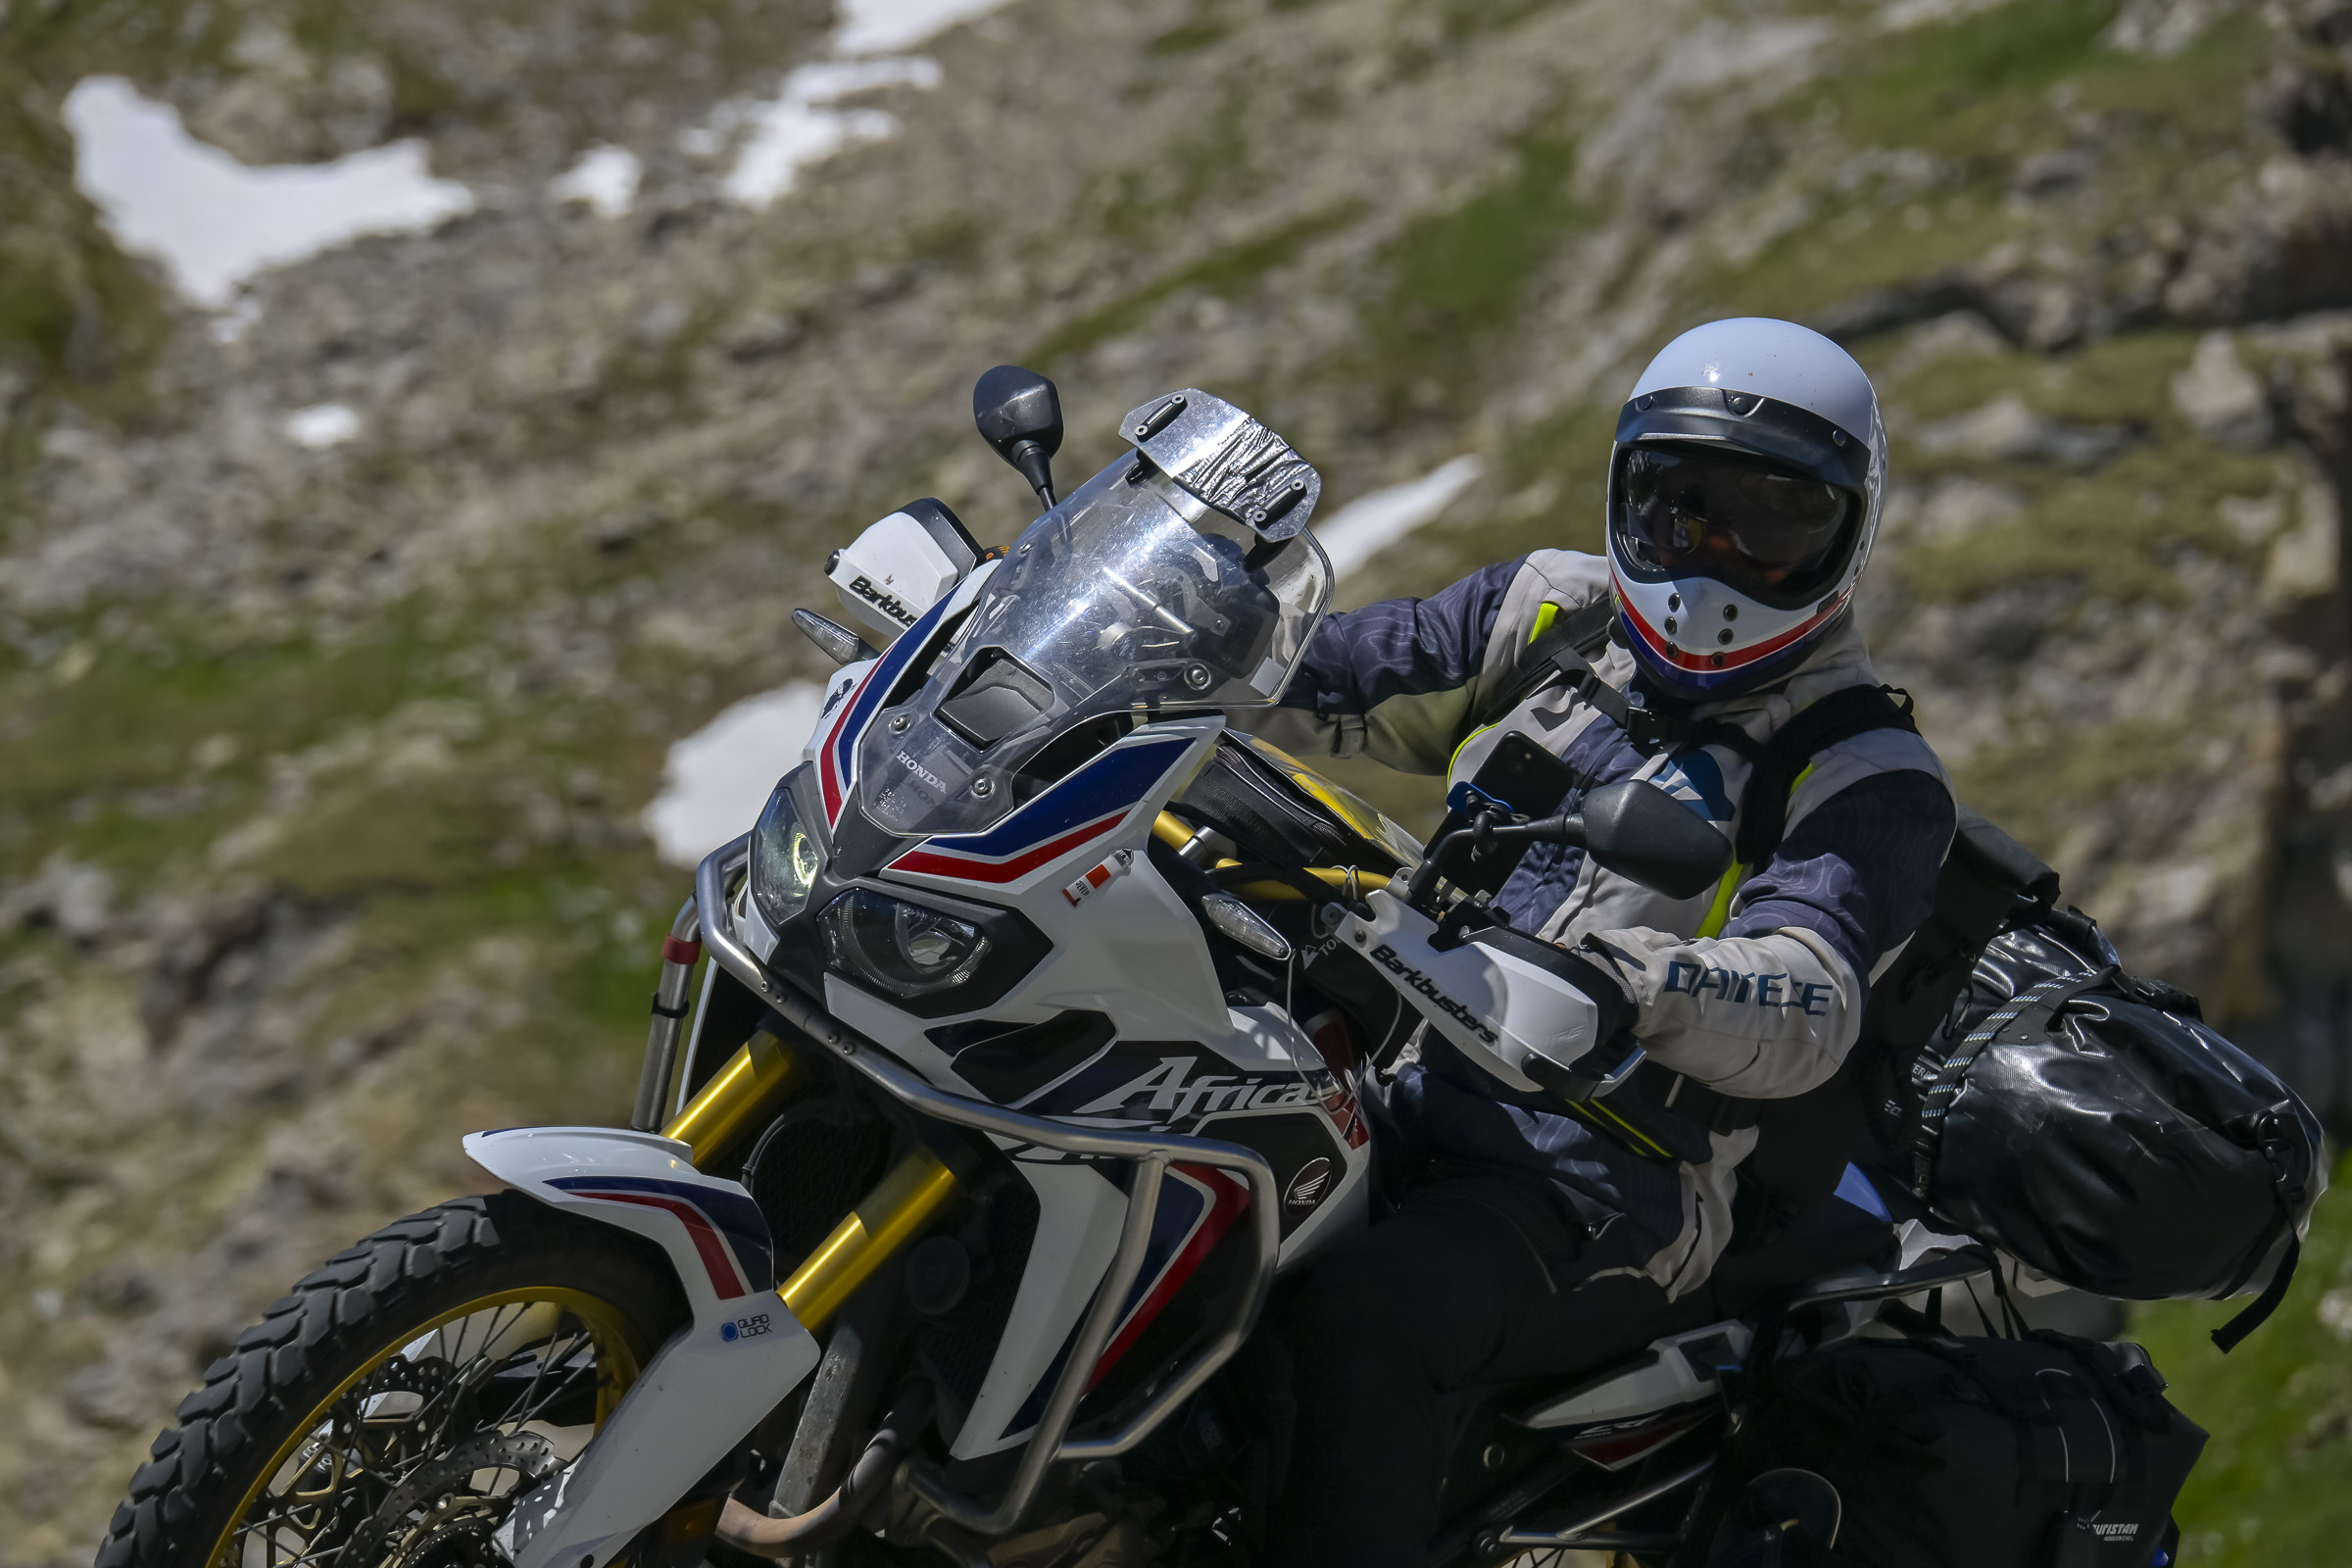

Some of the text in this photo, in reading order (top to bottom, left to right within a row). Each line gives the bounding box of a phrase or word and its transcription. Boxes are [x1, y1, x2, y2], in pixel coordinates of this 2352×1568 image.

[849, 575, 918, 627] Barkbus
[896, 750, 948, 794] HONDA
[1075, 880, 1091, 897] JEVER
[1369, 944, 1499, 1047] Barkbusters
[1072, 1055, 1330, 1125] Africa
[737, 1313, 770, 1329] QUAD
[739, 1323, 772, 1339] LOCK
